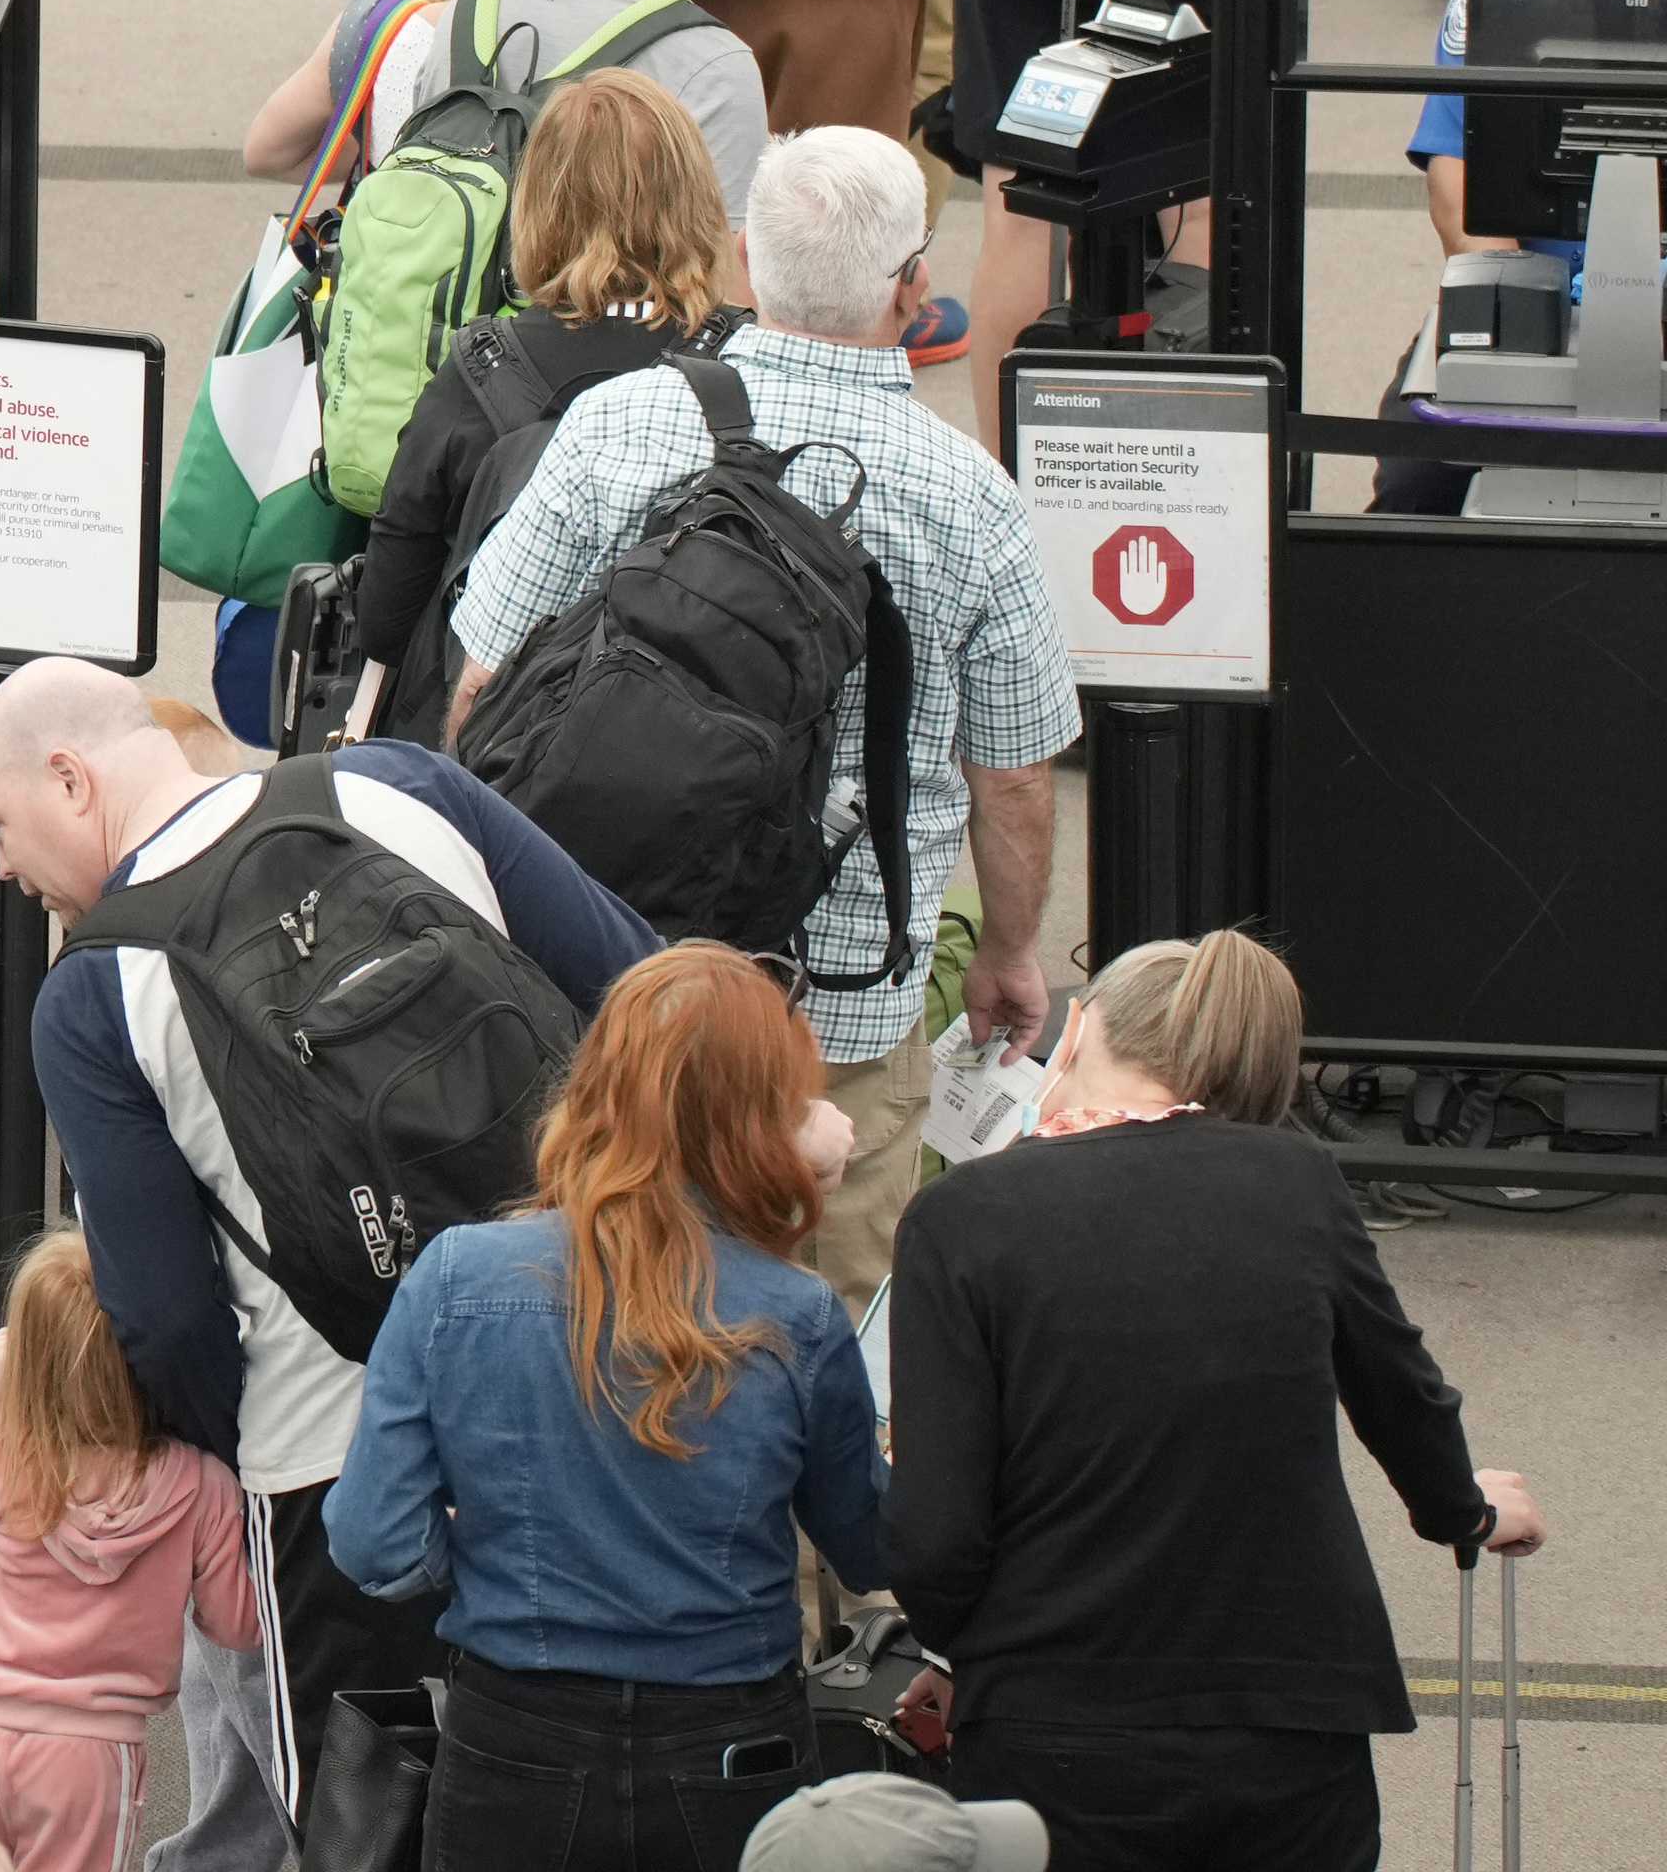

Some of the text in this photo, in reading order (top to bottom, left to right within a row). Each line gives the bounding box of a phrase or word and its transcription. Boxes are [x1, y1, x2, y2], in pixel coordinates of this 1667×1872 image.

[333, 309, 354, 413] patagonia
[7, 400, 59, 419] abuse.
[1034, 393, 1101, 408] Attention
[21, 427, 89, 447] violence
[1035, 439, 1196, 457] Please wait here until a
[1035, 457, 1199, 477] Transportation Security
[1035, 475, 1166, 492] Officer is available.
[42, 493, 53, 501] or
[55, 493, 80, 504] harm
[1035, 497, 1231, 516] Have I.D. and boarding pass ready.
[31, 503, 69, 516] Officers
[70, 507, 101, 521] during
[8, 515, 41, 526] pursue
[43, 518, 79, 530] criminal
[82, 522, 124, 534] penalties
[12, 555, 70, 570] cooperation.
[349, 1185, 398, 1279] OGIO
